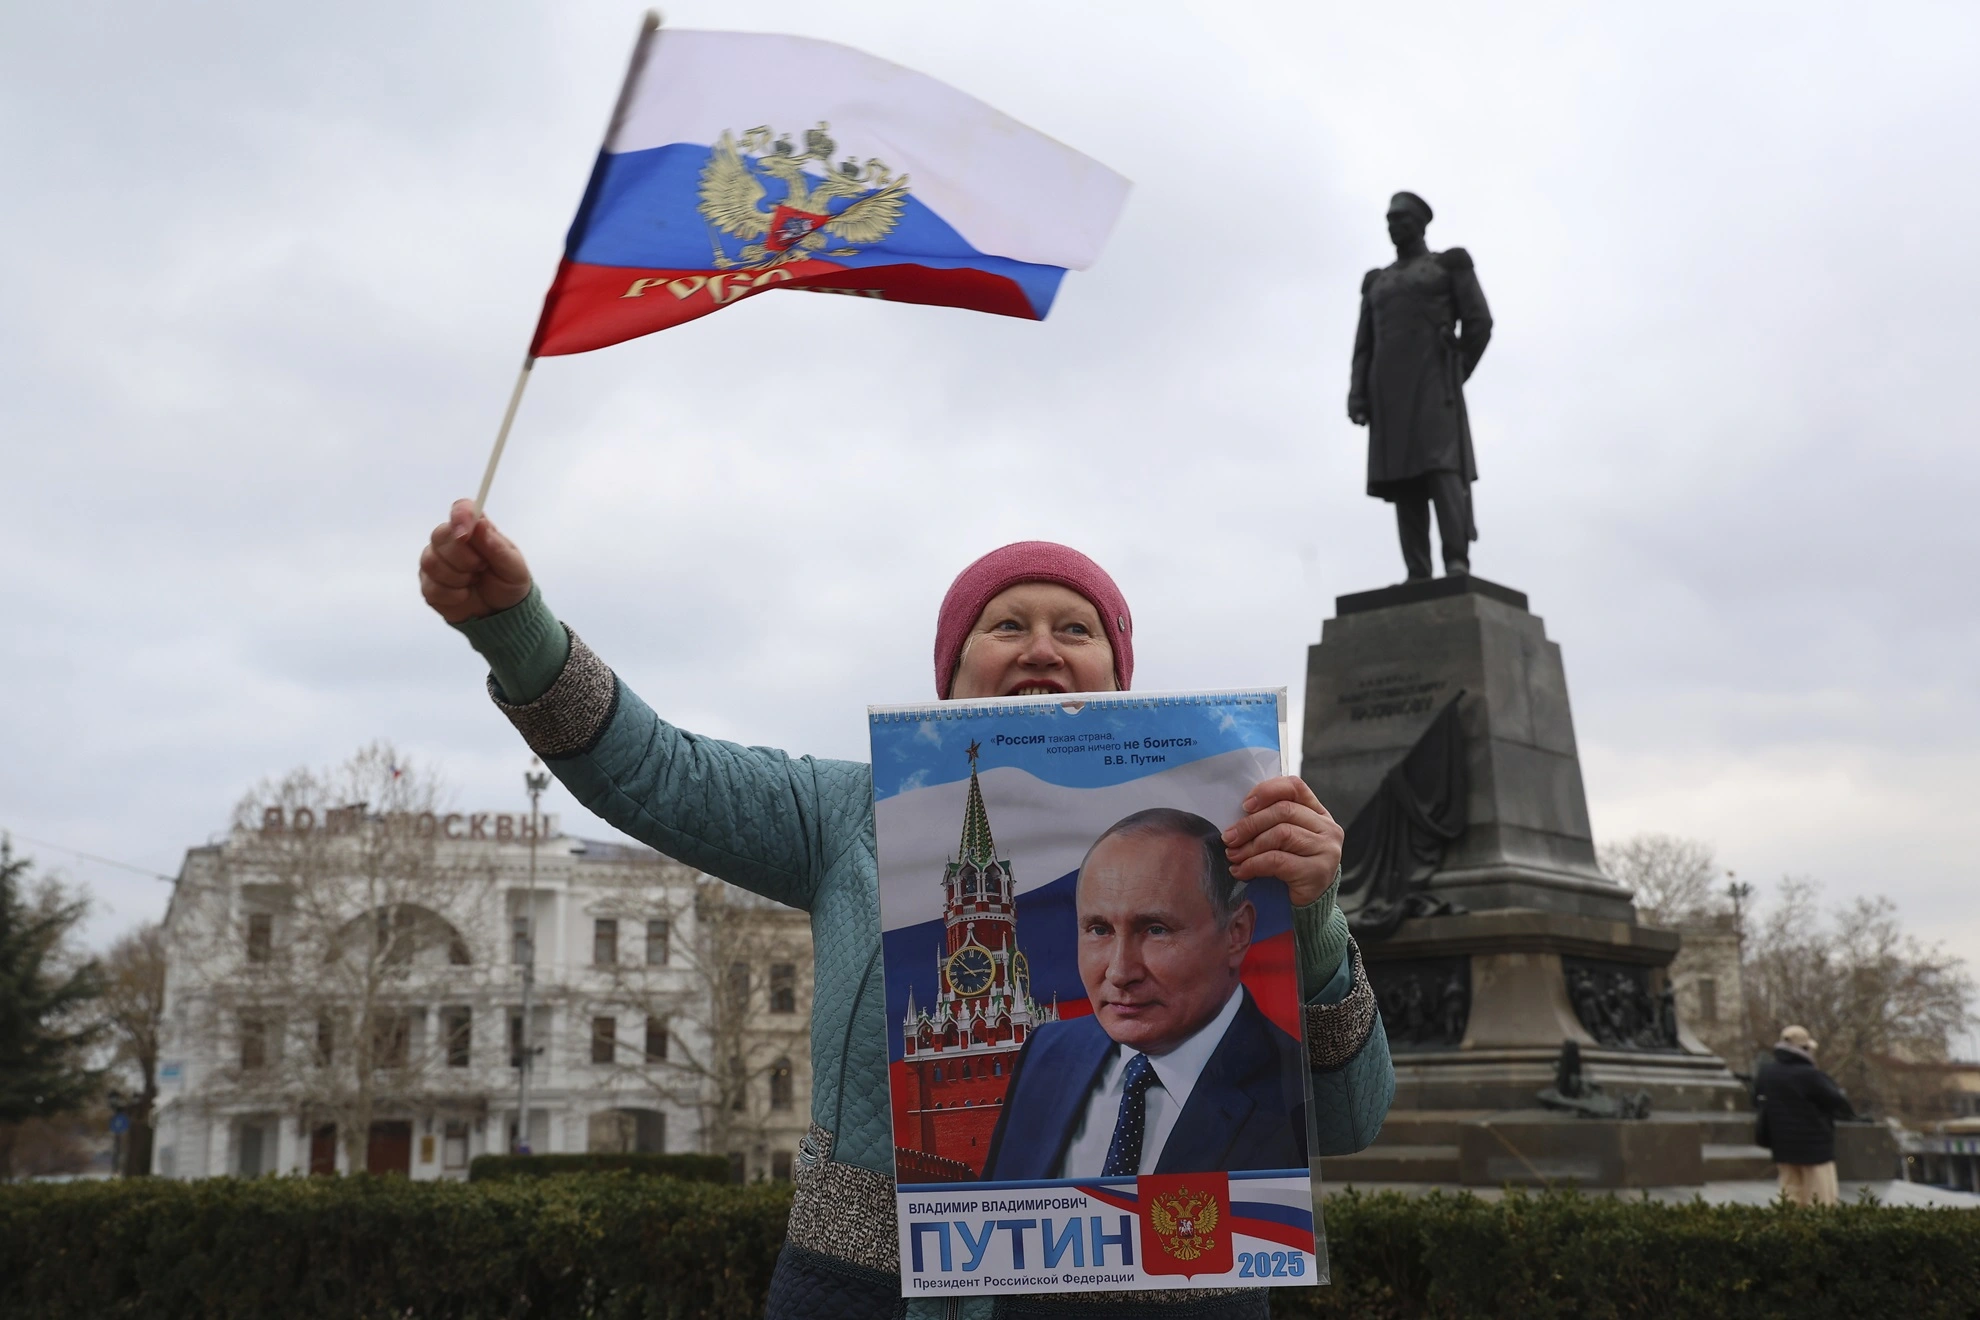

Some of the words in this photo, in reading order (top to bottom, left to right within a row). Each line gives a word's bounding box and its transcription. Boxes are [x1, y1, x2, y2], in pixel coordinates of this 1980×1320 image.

[991, 734, 1045, 746] «Россия
[1048, 734, 1076, 744] такая
[1078, 732, 1115, 743] страна,
[1046, 744, 1086, 755] которая
[1088, 742, 1121, 752] ничего
[1123, 740, 1140, 750] не
[1143, 737, 1198, 749] боится»
[1104, 755, 1128, 766] В.В.
[1130, 753, 1166, 766] Путин
[909, 1201, 978, 1215] ВЛАДИМИР
[982, 1198, 1087, 1213] ВЛАДИМИРОВИЧ
[910, 1214, 1134, 1273] ПУТИН
[1238, 1251, 1305, 1278] 2025
[913, 1276, 980, 1290] Президент
[984, 1274, 1059, 1287] Российской
[1062, 1273, 1135, 1285] Федерации
